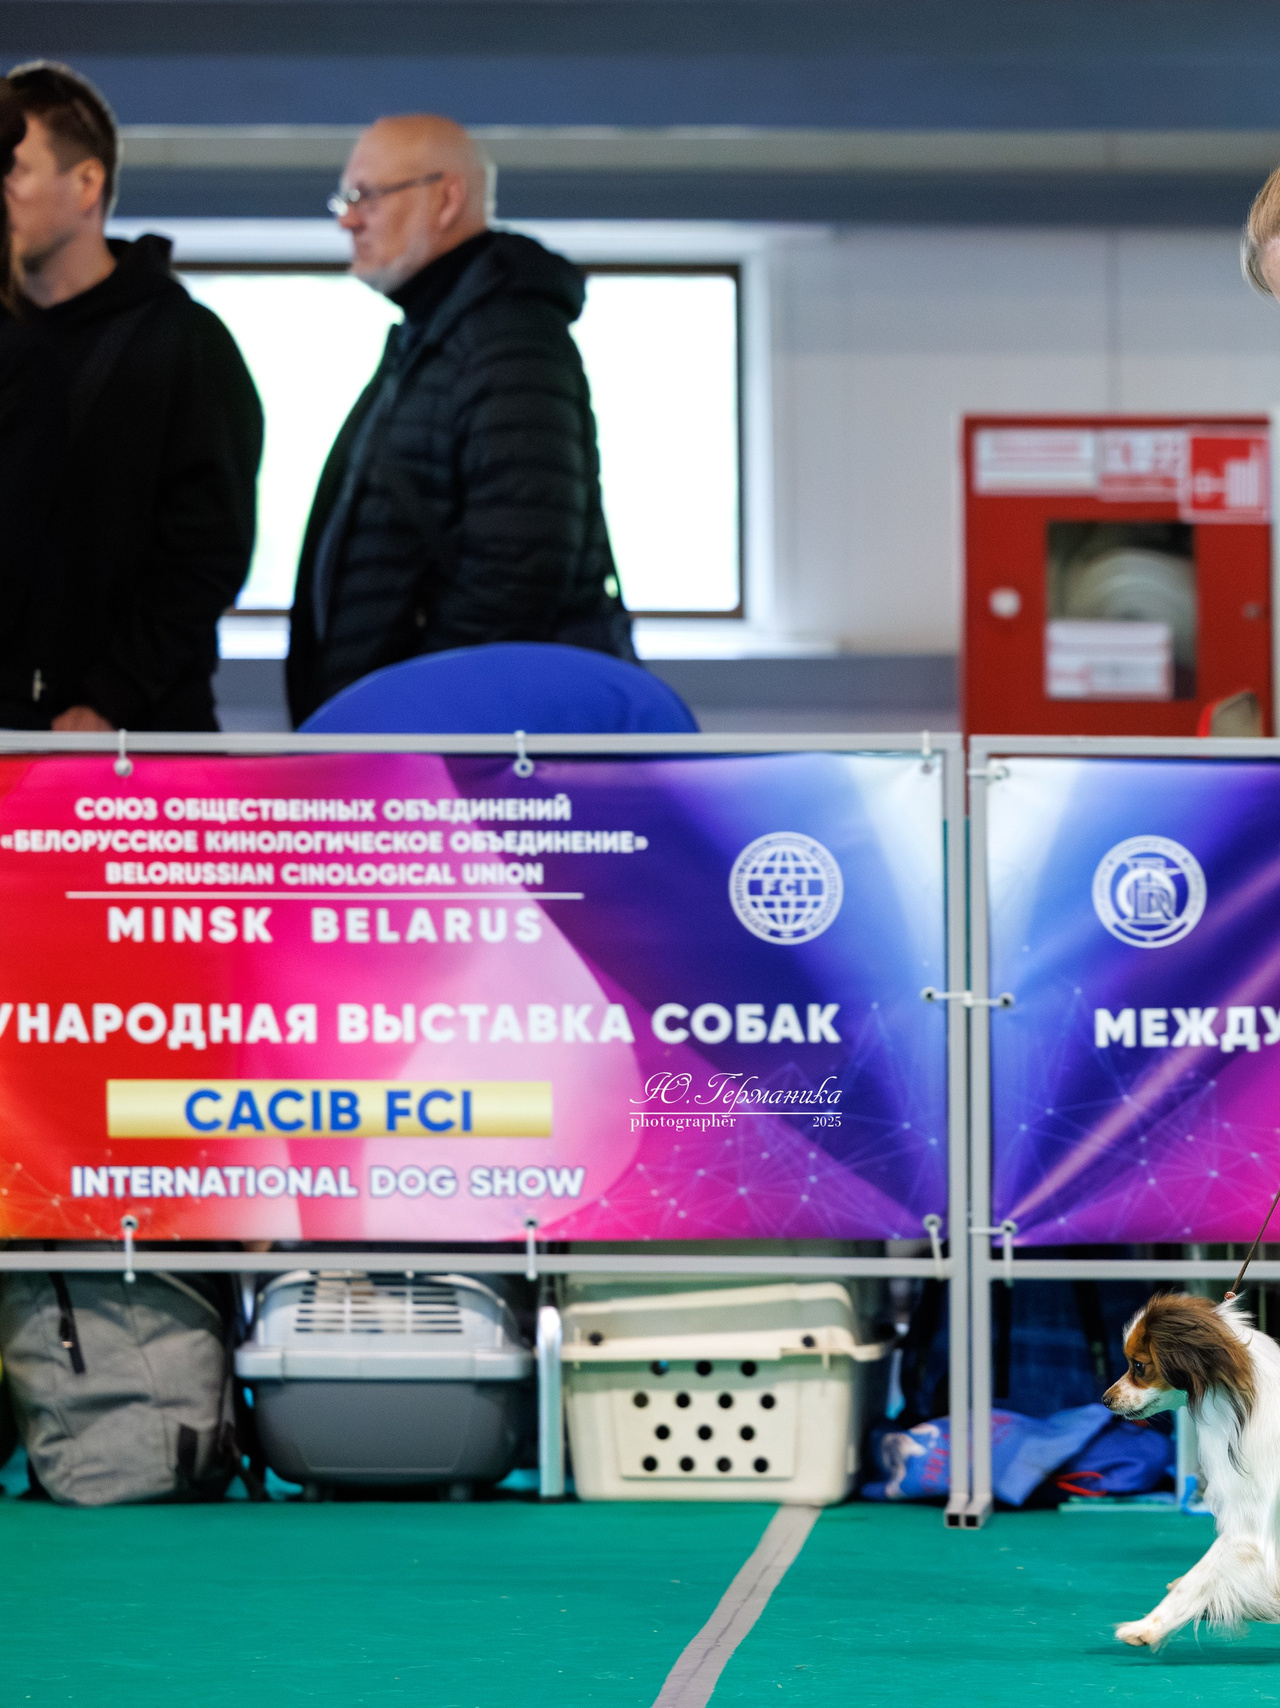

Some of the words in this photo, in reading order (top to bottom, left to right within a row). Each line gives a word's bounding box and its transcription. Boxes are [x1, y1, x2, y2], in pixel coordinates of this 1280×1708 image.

[74, 797, 158, 821] СОЮЗ
[163, 797, 376, 824] ОБЩЕСТВЕННЫХ
[382, 793, 572, 824] ОБЪЕДИНЕНИЙ
[1, 829, 198, 853] «БЕЛОРУССКОЕ
[205, 830, 443, 854] КИНОЛОГИЧЕСКОЕ
[450, 830, 649, 856] ОБЪЕДИНЕНИЕ»
[105, 861, 274, 885] BELORUSSIAN
[280, 862, 456, 886] CINOLOGICAL
[462, 862, 544, 886] UNION
[762, 879, 808, 896] FCI
[107, 906, 273, 943] MINSK
[311, 907, 543, 944] BELARUS
[337, 1002, 635, 1045] ВЫСТАВКА
[650, 1002, 842, 1045] СОБАК
[184, 1088, 362, 1133] CACIB
[385, 1089, 473, 1133] FCI
[71, 1166, 358, 1198] INTERNATIONAL
[369, 1166, 458, 1199] DOG
[470, 1166, 586, 1199] SHOW
